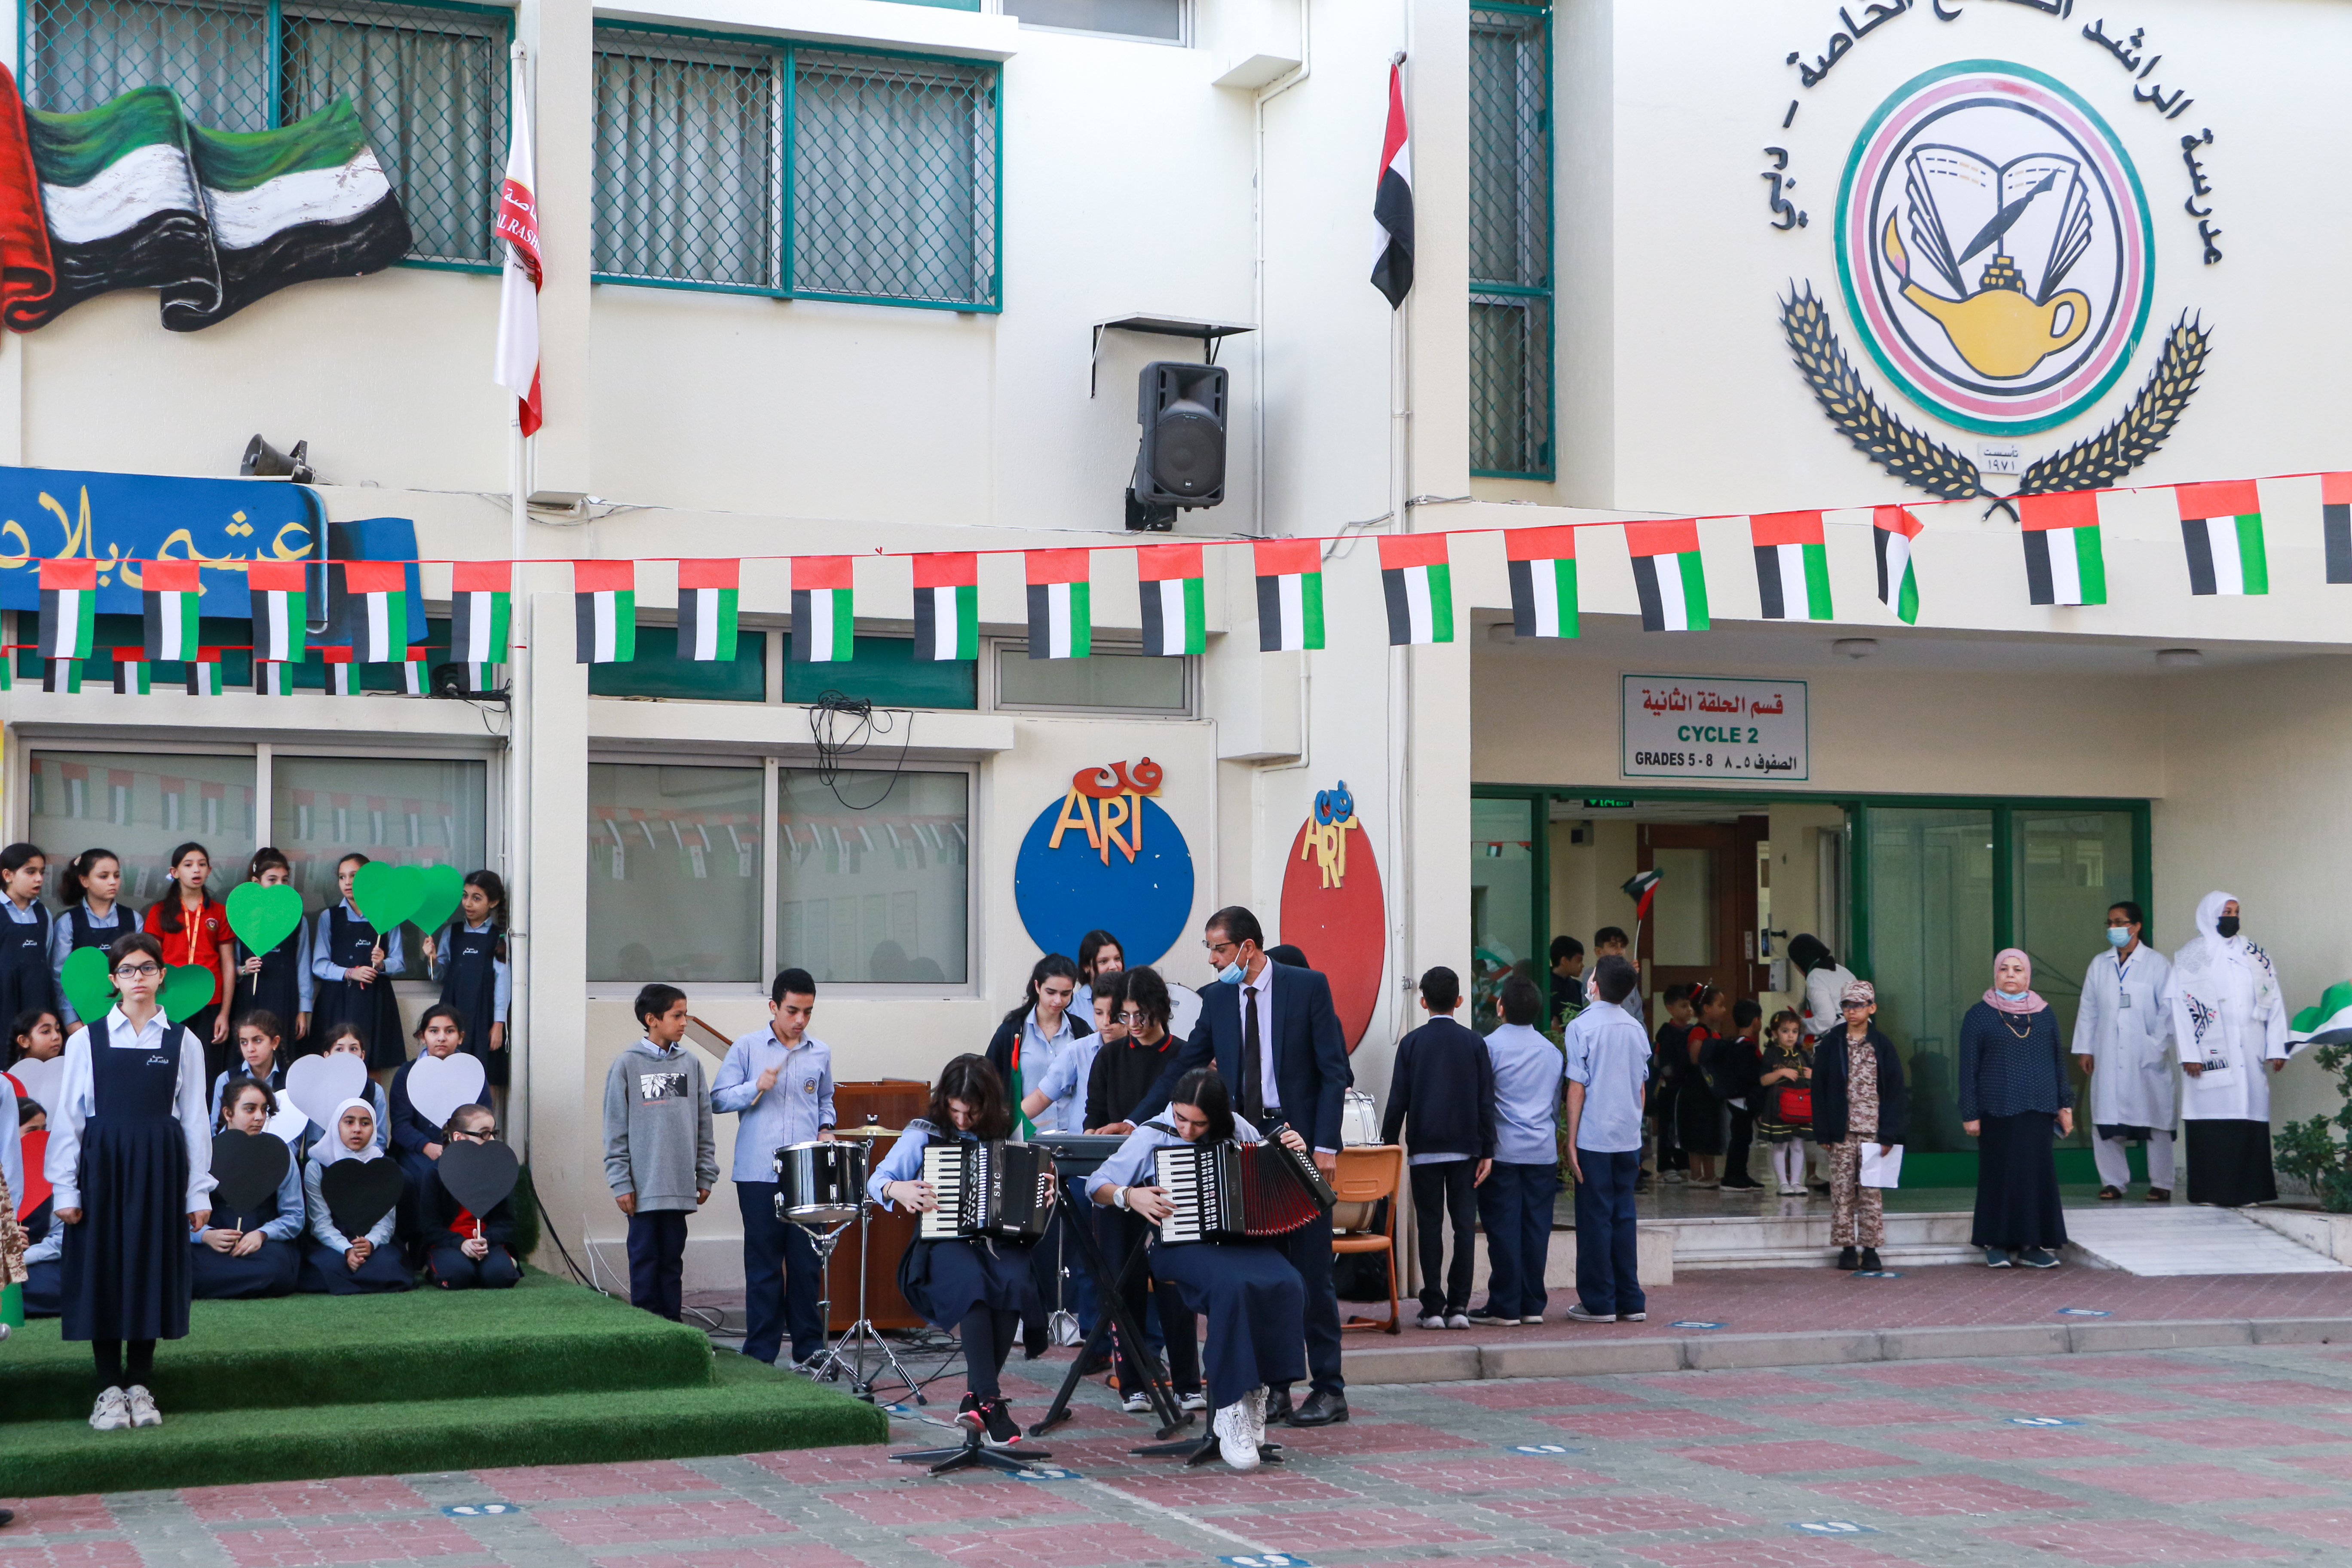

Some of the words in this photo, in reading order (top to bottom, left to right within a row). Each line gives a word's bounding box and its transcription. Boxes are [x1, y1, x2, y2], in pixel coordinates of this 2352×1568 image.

[2082, 18, 2194, 119] الراشد
[1761, 147, 1809, 230] دبي
[2181, 128, 2222, 265] مدرسة
[1984, 445, 2018, 457] تأسست
[1989, 459, 2014, 471] ١٩٧١
[1642, 688, 1692, 717] الثانية
[1697, 692, 1746, 713] الحلقة
[1751, 694, 1783, 719] قسم
[1678, 726, 1741, 743] CYCLE
[1748, 727, 1758, 744] 2
[1635, 751, 1684, 766] GRADES
[1688, 753, 1695, 766] 5
[1706, 753, 1713, 767] 8
[1725, 756, 1732, 769] ٨
[1744, 756, 1750, 768] ٥
[1754, 753, 1797, 774] الصفوف
[1049, 784, 1162, 867] ART
[1302, 800, 1358, 888] ART
